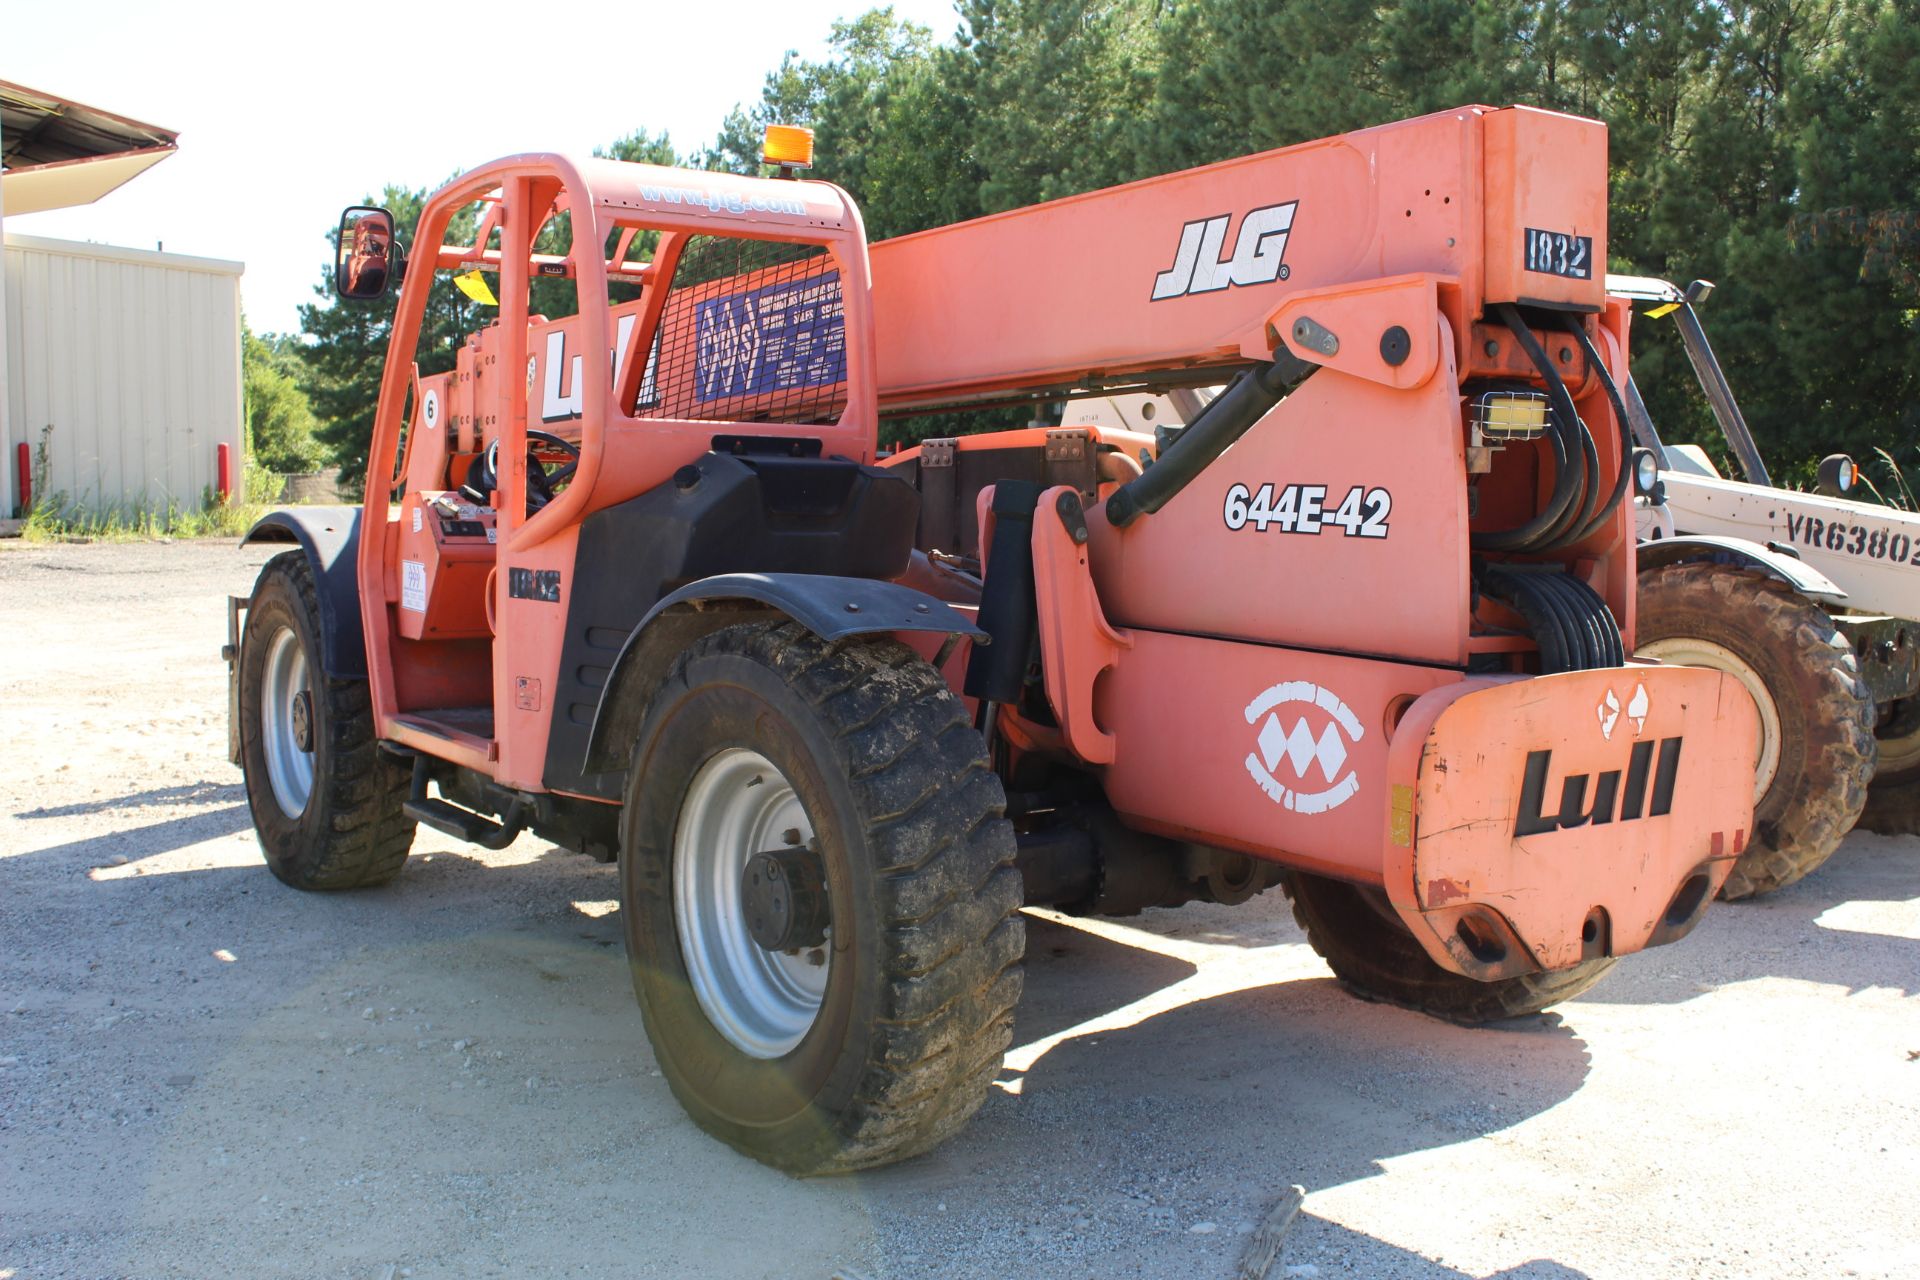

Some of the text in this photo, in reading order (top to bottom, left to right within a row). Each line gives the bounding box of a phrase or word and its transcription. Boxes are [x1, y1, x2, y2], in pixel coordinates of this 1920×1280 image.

[635, 184, 806, 216] www.jlg.com
[1151, 200, 1299, 302] JLG
[1529, 230, 1586, 277] 1832
[1224, 482, 1392, 539] 644E-42
[1514, 736, 1683, 838] Lull
